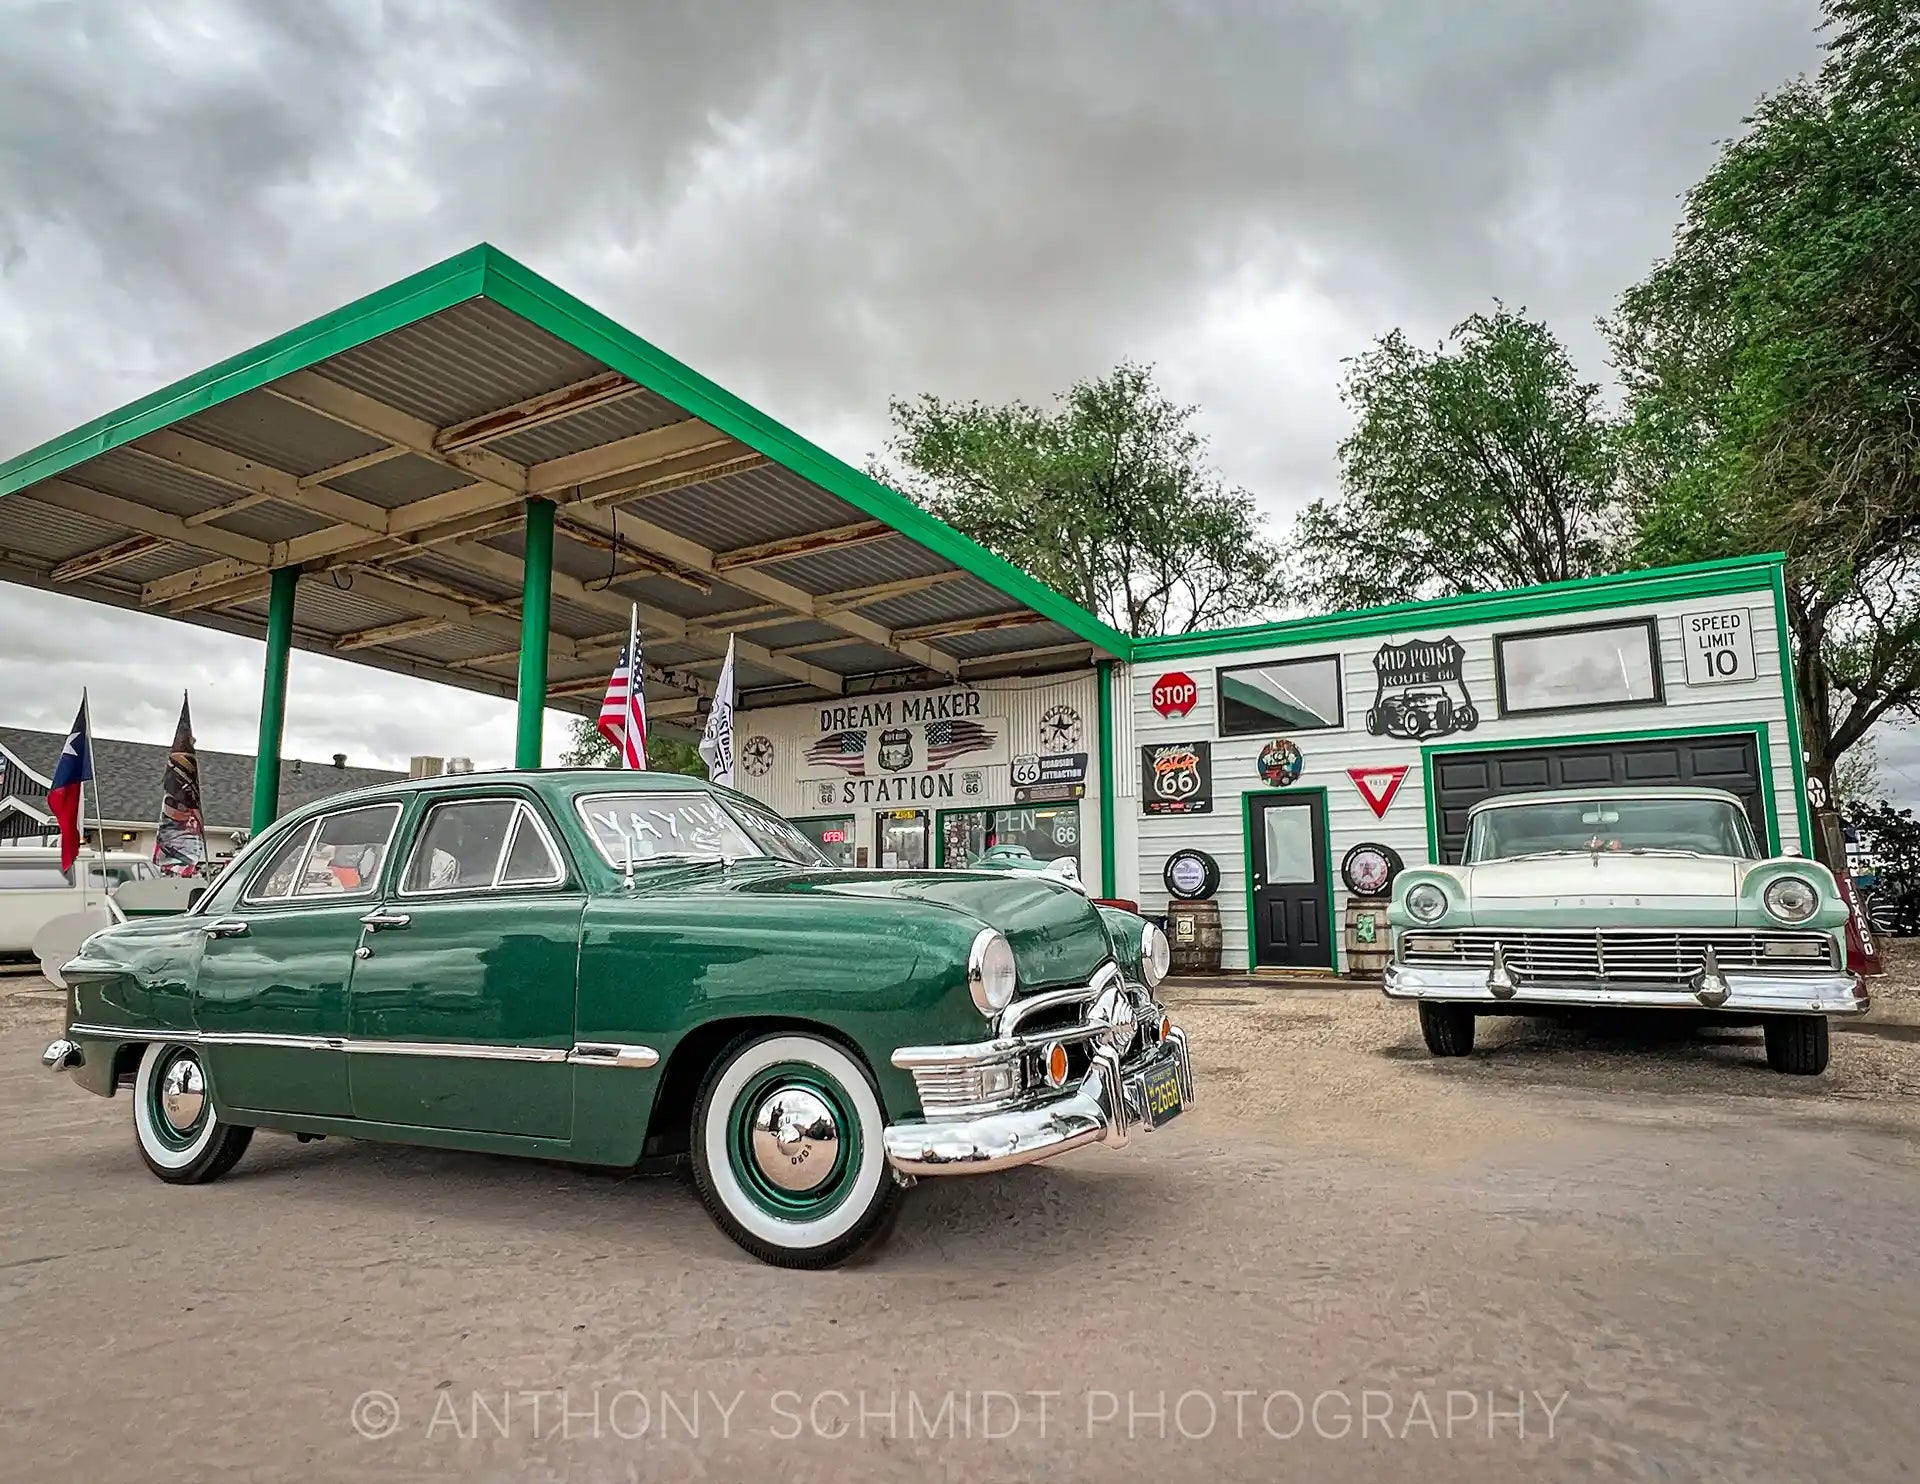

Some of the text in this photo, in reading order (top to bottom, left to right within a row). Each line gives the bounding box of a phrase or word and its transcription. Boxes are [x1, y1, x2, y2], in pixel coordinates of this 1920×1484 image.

[1691, 614, 1741, 632] SPEED
[1698, 631, 1736, 649] LIMIT
[1378, 642, 1456, 671] MID POINT
[1703, 649, 1738, 677] 10
[1383, 671, 1431, 687] ROUTE
[1154, 684, 1195, 706] STOP
[820, 691, 981, 732] DREAM MAKER
[1017, 764, 1036, 781] 66
[1041, 769, 1082, 780] ATTRACTION
[842, 773, 954, 804] STATION
[966, 783, 979, 794] 66
[1163, 771, 1193, 794] 66
[821, 794, 833, 804] 66
[980, 808, 1036, 832] OPEN
[823, 831, 845, 843] OPEN
[1056, 827, 1076, 843] 66
[1844, 878, 1873, 957] TEXACO
